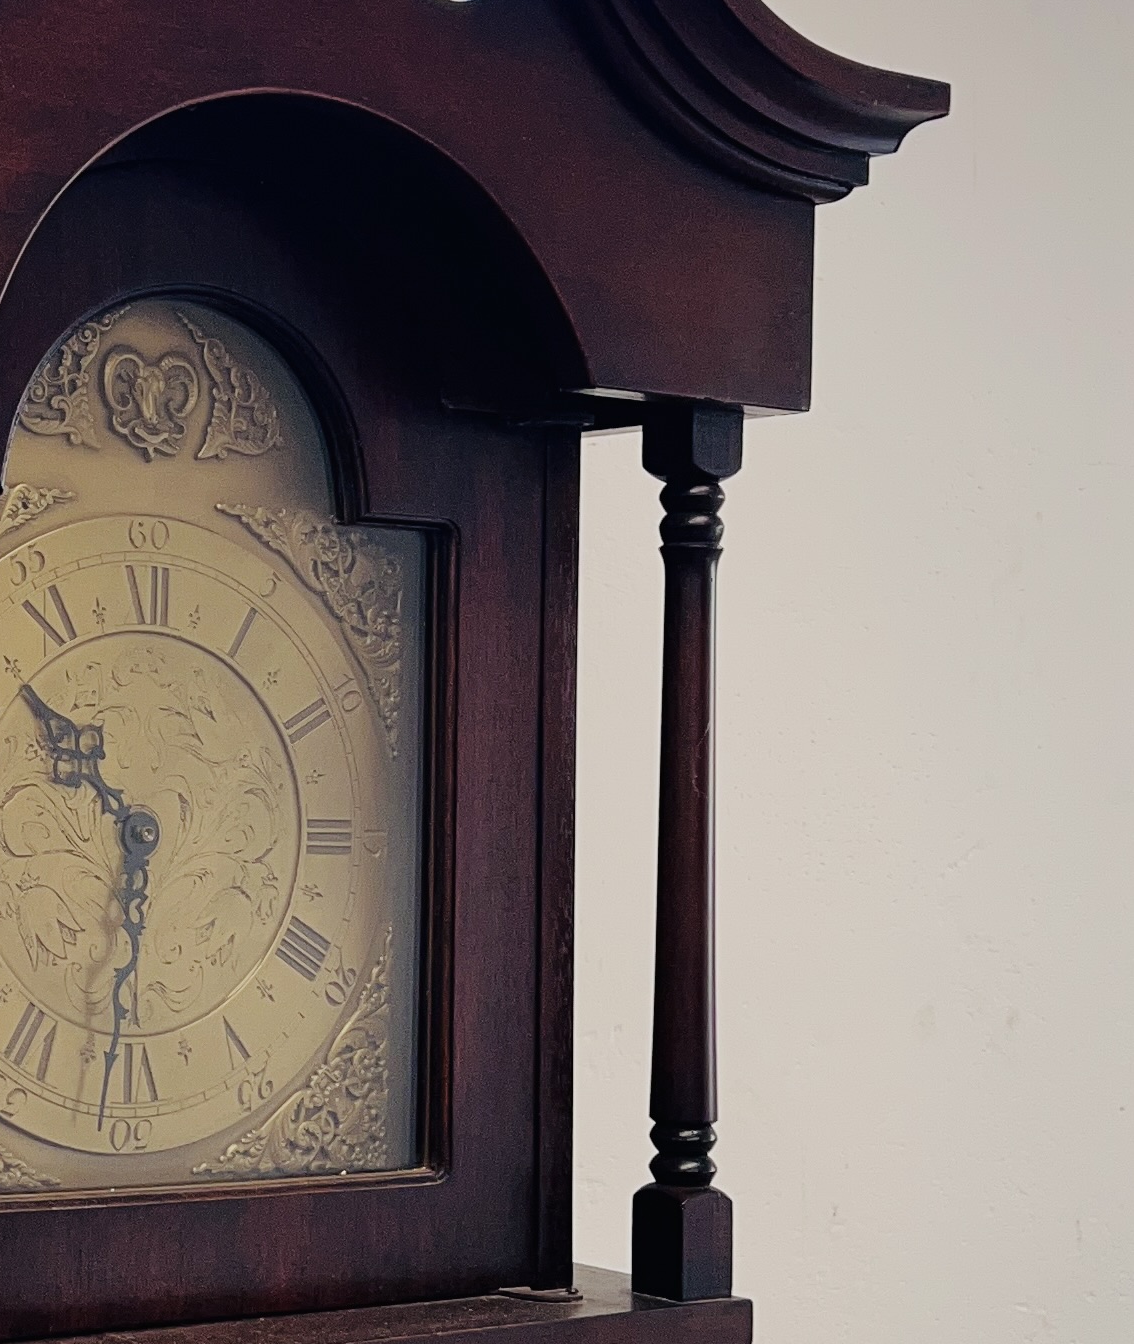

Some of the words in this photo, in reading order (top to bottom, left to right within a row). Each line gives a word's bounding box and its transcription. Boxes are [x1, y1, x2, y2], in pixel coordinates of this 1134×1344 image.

[129, 520, 169, 550] 60
[9, 544, 46, 586] 55
[259, 572, 282, 598] 5
[22, 585, 77, 657] XI
[333, 674, 362, 712] 10
[283, 697, 332, 744] II
[307, 818, 352, 855] III
[325, 952, 356, 1007] 20
[3, 1002, 58, 1082] VII
[119, 1042, 160, 1105] VI
[237, 1067, 273, 1112] 25
